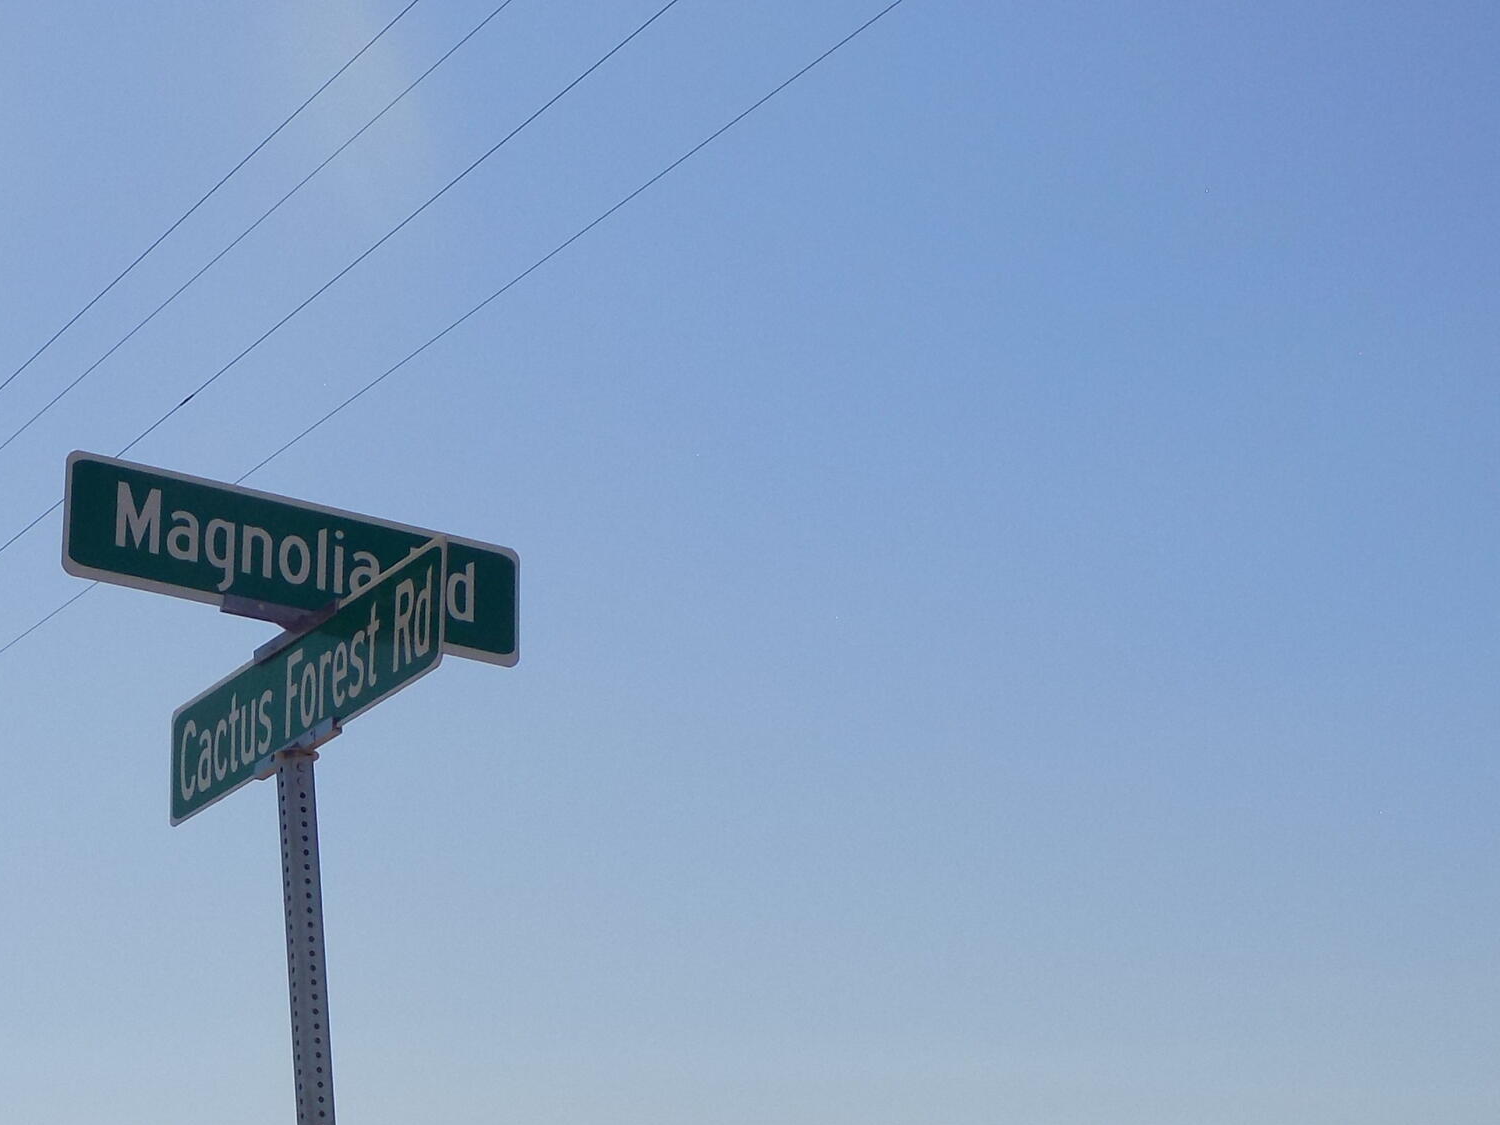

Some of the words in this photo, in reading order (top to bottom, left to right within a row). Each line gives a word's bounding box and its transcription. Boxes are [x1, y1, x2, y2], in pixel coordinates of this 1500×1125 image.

[114, 480, 381, 595] Magnolia
[180, 688, 273, 801] Cactus
[284, 601, 381, 740] Forest
[392, 565, 434, 673] Rd
